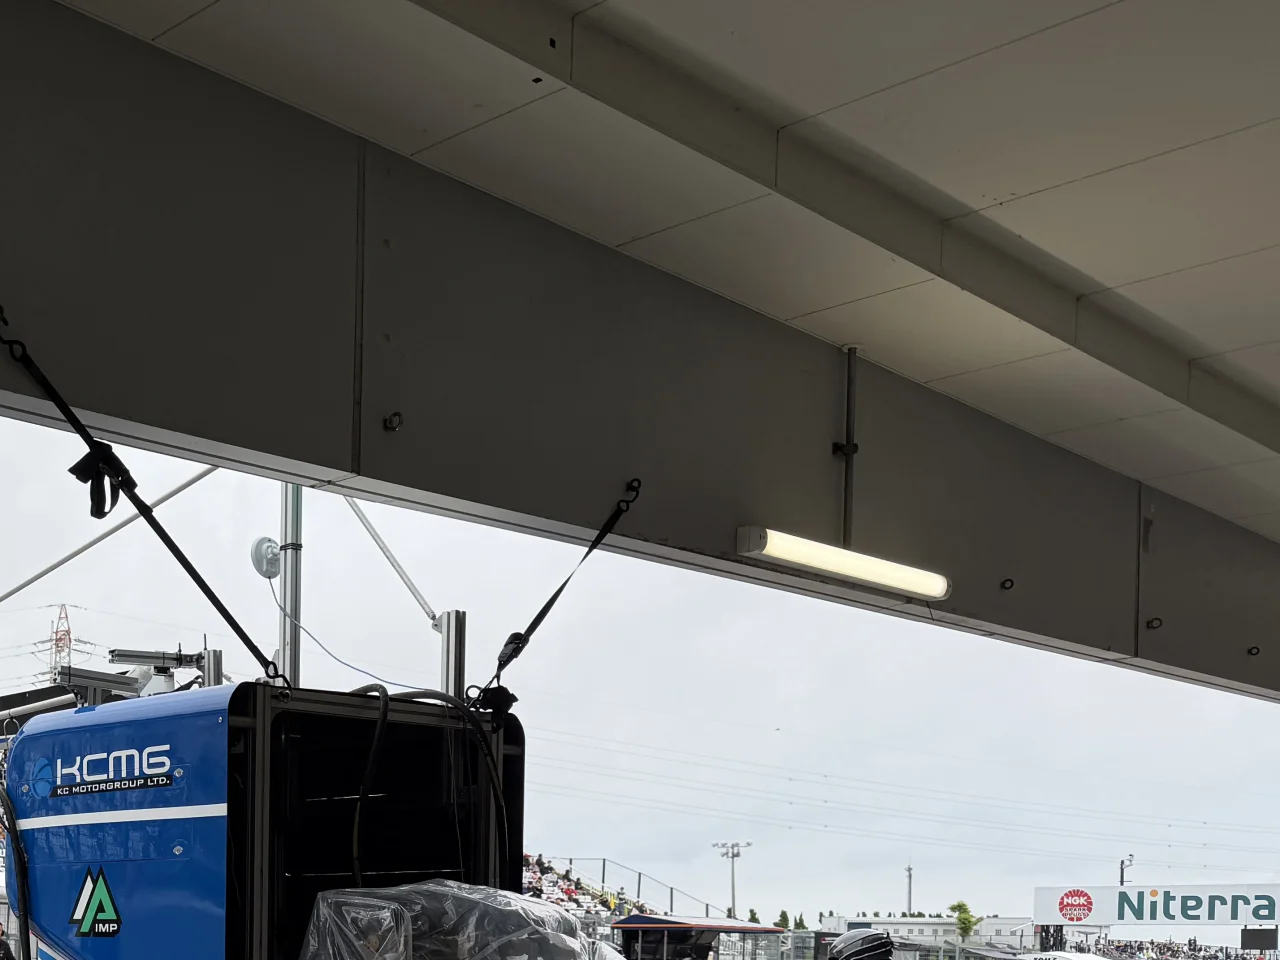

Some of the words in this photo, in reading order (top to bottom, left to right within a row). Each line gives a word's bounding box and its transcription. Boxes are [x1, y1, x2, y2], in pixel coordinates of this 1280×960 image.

[57, 744, 171, 785] KCMG
[57, 787, 70, 796] KC
[72, 779, 145, 795] MOTORGROUP
[147, 776, 170, 786] LTD.
[1063, 896, 1088, 905] NGK
[1117, 889, 1276, 921] Niterra
[95, 923, 118, 933] IMP
